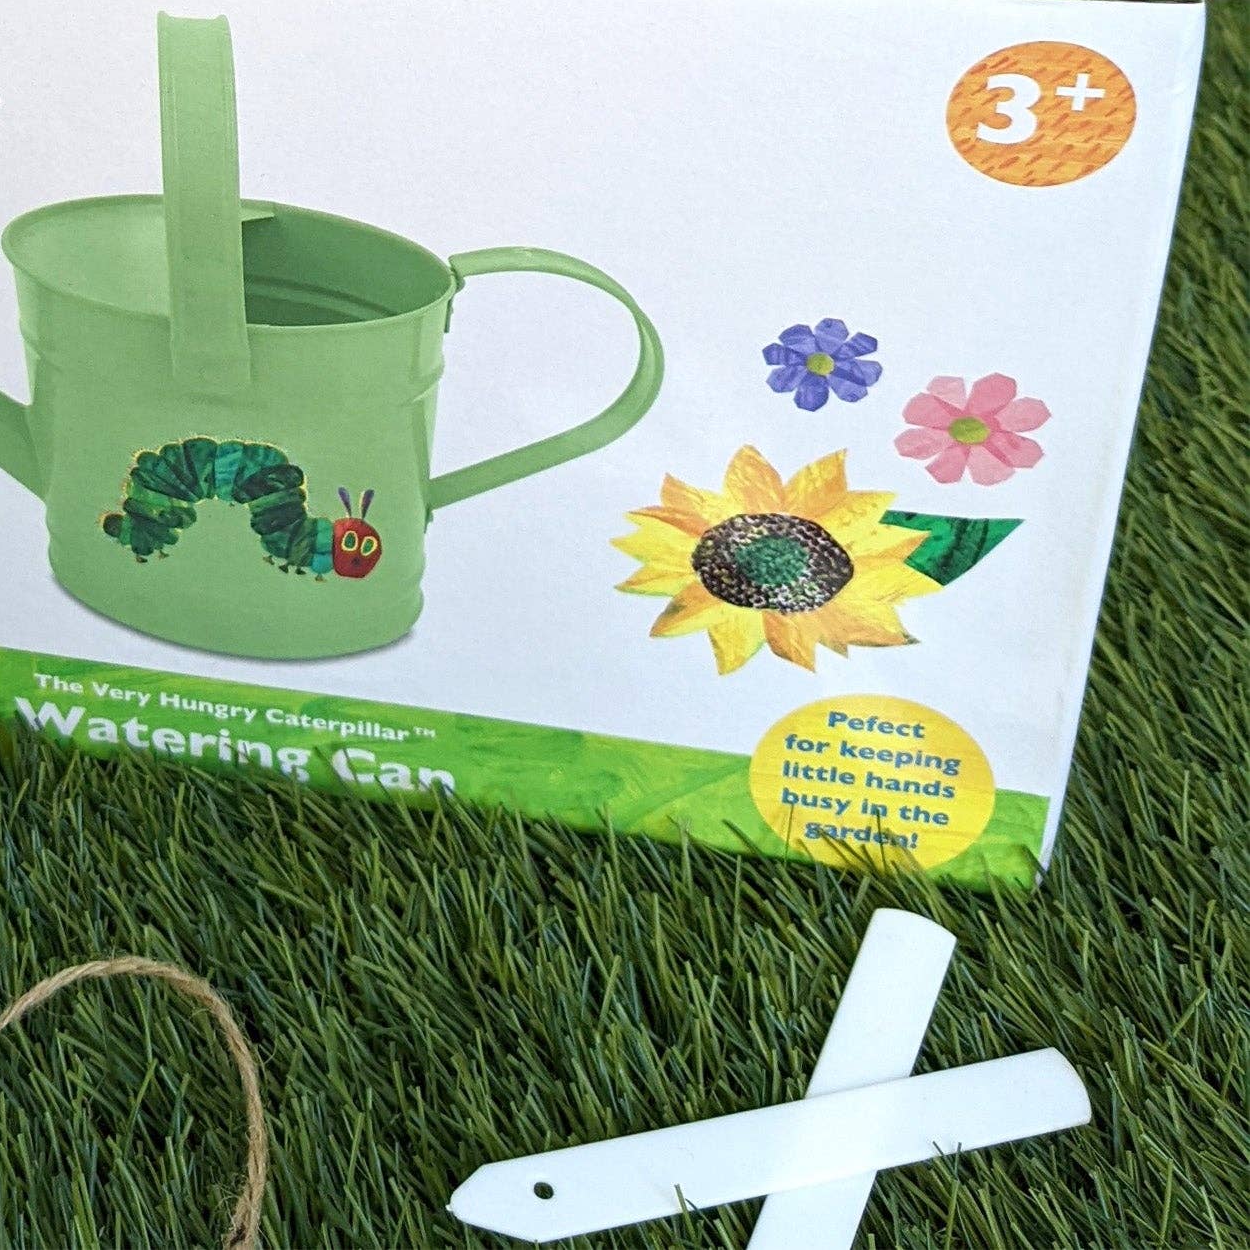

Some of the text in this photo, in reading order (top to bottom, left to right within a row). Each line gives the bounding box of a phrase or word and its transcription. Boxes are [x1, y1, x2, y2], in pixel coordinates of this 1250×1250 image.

[975, 73, 1106, 145] 3+
[33, 673, 84, 695] The
[91, 681, 151, 708] Very
[160, 691, 258, 725] Hungry
[828, 710, 926, 739] Pefect
[14, 696, 456, 798] Watering Can
[784, 733, 962, 776] for keeping
[782, 760, 956, 799] little hands
[781, 787, 950, 826] busy in the
